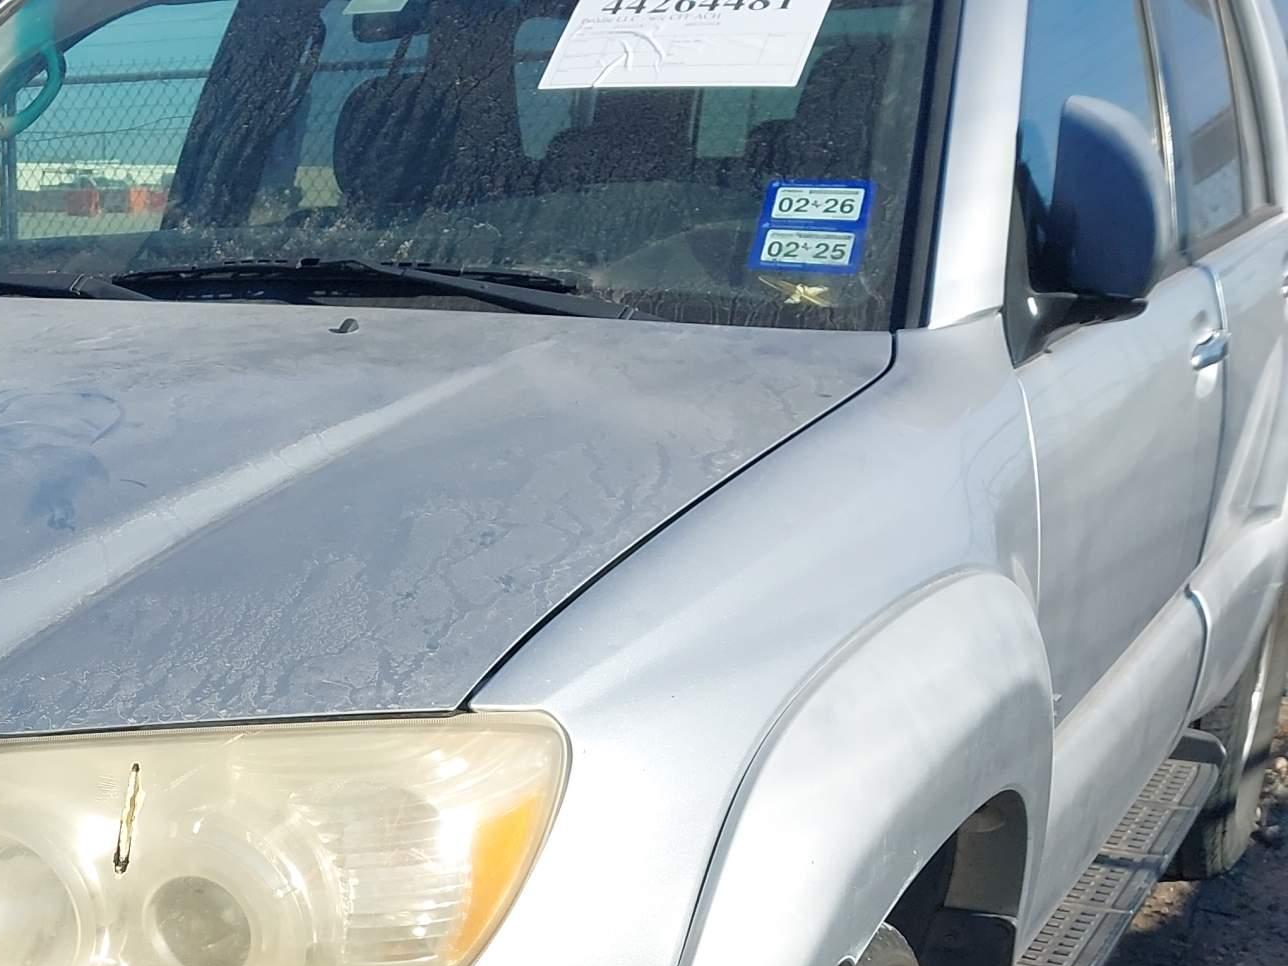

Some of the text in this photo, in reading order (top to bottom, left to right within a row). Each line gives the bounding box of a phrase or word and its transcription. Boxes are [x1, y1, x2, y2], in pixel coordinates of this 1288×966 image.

[601, 0, 792, 14] 44264481
[778, 197, 855, 214] 02 26
[767, 240, 848, 260] 02 25
